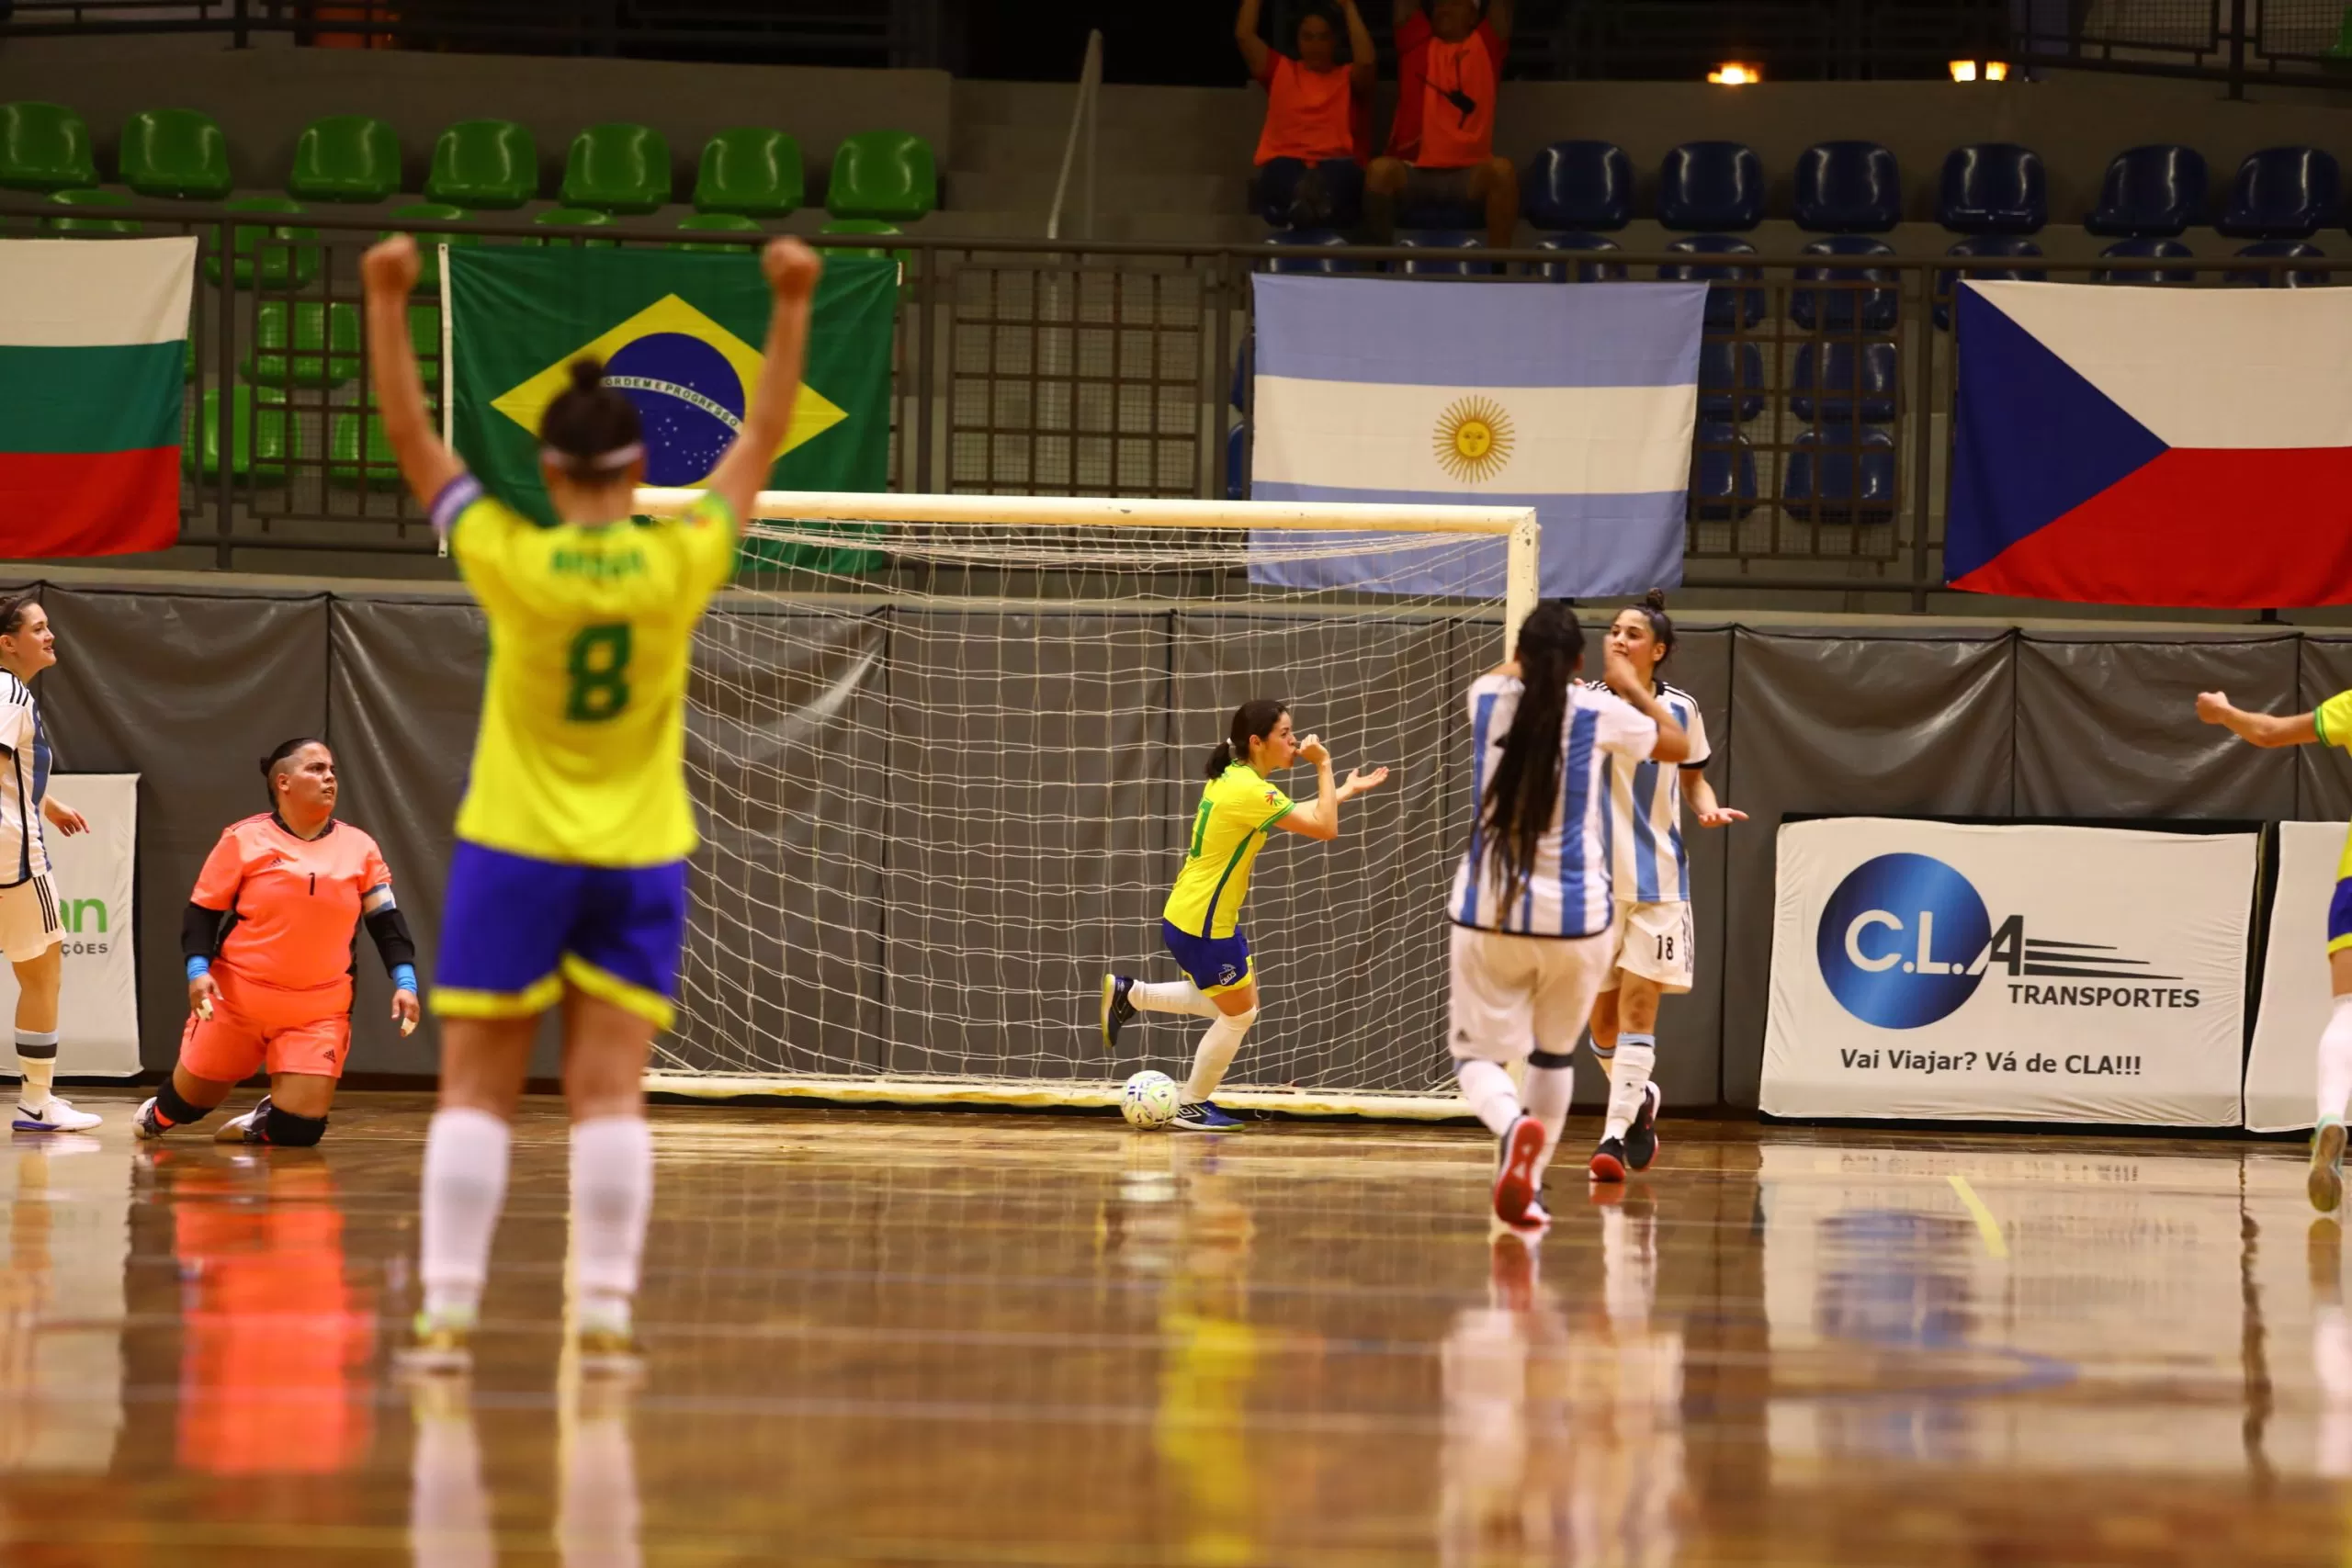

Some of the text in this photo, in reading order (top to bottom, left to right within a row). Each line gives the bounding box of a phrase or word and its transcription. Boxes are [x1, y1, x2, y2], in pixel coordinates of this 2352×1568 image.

[605, 378, 651, 389] ORDEM
[664, 383, 739, 427] PROGRESSO
[565, 625, 631, 722] 8
[308, 872, 316, 897] 1
[1657, 934, 1674, 961] 18
[2008, 984, 2200, 1009] TRANSPORTES
[1840, 1048, 2142, 1076] Vai Viajar? Vá de CLA!!!
